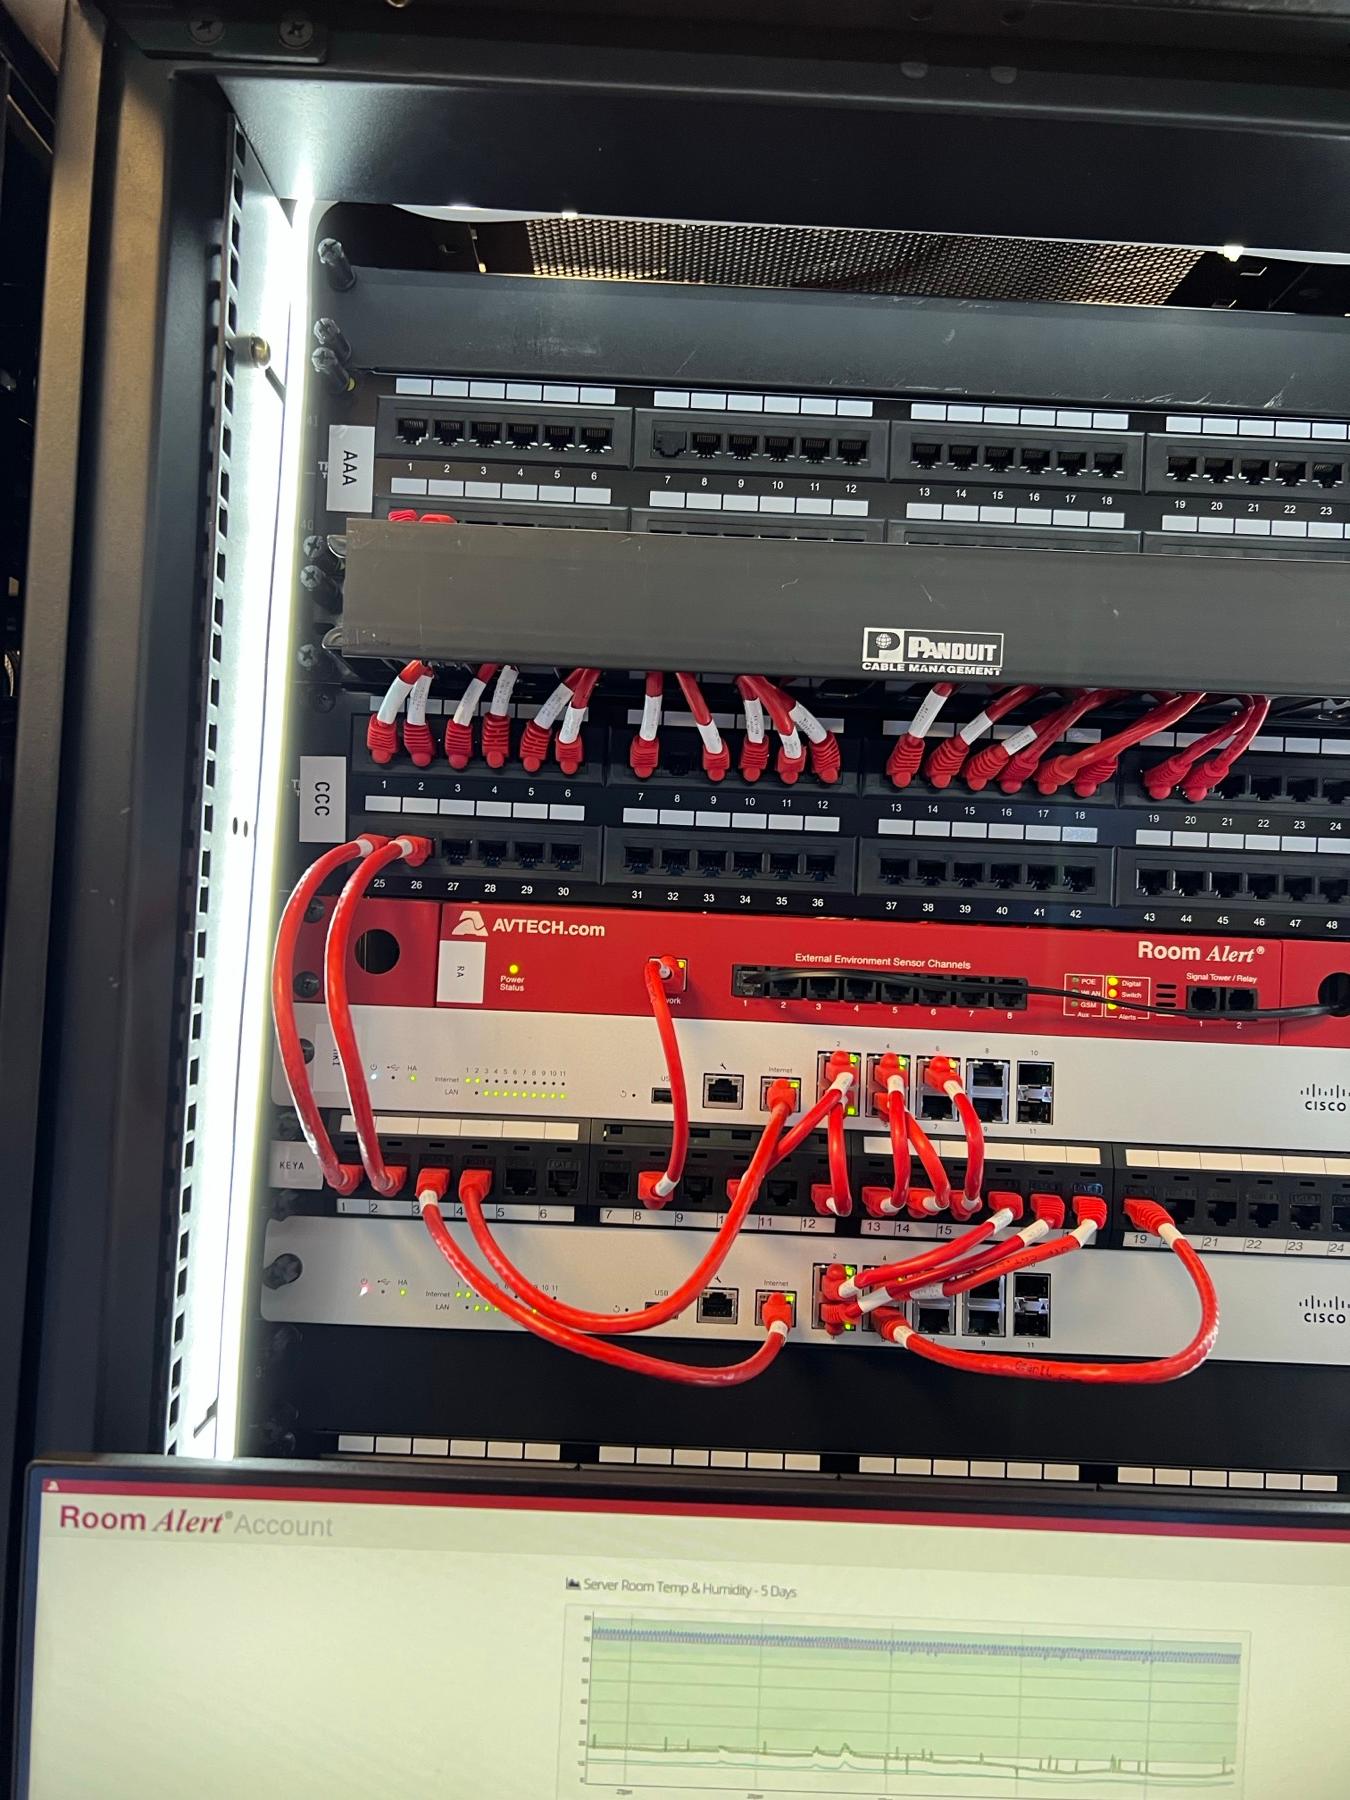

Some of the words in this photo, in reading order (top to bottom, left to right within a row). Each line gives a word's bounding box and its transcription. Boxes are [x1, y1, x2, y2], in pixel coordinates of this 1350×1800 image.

[343, 451, 357, 485] AAA
[444, 464, 449, 472] 2
[518, 468, 523, 476] 4
[555, 470, 560, 478] 5
[591, 472, 597, 480] 6
[665, 476, 670, 484] 7
[702, 478, 707, 486] 8
[738, 479, 744, 487] 9
[773, 481, 783, 489] 10
[811, 483, 819, 491] 11
[846, 484, 856, 493] 12
[920, 488, 929, 496] 13
[993, 491, 1003, 499] 15
[1029, 493, 1039, 501] 16
[1066, 495, 1076, 503] 17
[1211, 502, 1222, 510] 20
[1285, 505, 1295, 513] 22
[1320, 507, 1332, 515] 23
[907, 636, 998, 662] PANDUIT
[862, 662, 905, 672] CABLE
[908, 664, 1002, 676] MANAGEMENT
[315, 782, 330, 816] CCC
[418, 782, 424, 790] 2
[455, 784, 460, 792] 3
[529, 788, 534, 796] 5
[565, 789, 571, 797] 6
[675, 794, 680, 802] 8
[711, 796, 716, 804] 9
[818, 801, 828, 809] 12
[892, 804, 901, 812] 13
[928, 805, 937, 813] 14
[1002, 808, 1012, 816] 16
[1185, 816, 1196, 824] 20
[1294, 821, 1305, 829] 23
[1330, 822, 1341, 830] 24
[374, 879, 385, 888] 25
[411, 881, 422, 889] 26
[448, 882, 459, 890] 27
[485, 884, 496, 892] 28
[521, 886, 532, 894] 29
[558, 887, 569, 895] 30
[668, 892, 678, 900] 32
[704, 894, 714, 902] 33
[777, 897, 787, 905] 35
[886, 902, 897, 910] 37
[923, 903, 933, 911] 38
[960, 905, 971, 913] 39
[1070, 910, 1081, 918] 42
[1144, 913, 1155, 921] 43
[1218, 916, 1228, 924] 45
[1254, 918, 1265, 926] 46
[1326, 921, 1337, 929] 48
[492, 918, 605, 937] AVTECH.com
[1138, 941, 1201, 961] Room
[795, 953, 832, 963] External
[834, 955, 891, 966] Environment
[893, 957, 925, 967] Sensor
[928, 959, 971, 970] Channels
[499, 983, 525, 992] Status
[500, 975, 525, 984] Power
[1121, 980, 1141, 988] Digital
[1186, 973, 1208, 982] Signal
[1209, 973, 1232, 982] Tower
[1236, 975, 1258, 984] Relay
[930, 1008, 936, 1016] 6
[1304, 1100, 1346, 1112] CISCO
[280, 1161, 304, 1170] KEYA
[370, 1204, 378, 1213] 2
[412, 1204, 420, 1216] 3
[456, 1206, 464, 1217] 4
[496, 1206, 504, 1218] 5
[539, 1208, 547, 1219] 6
[606, 1209, 612, 1219] 7
[634, 1210, 642, 1221] 8
[676, 1212, 684, 1223] 9
[760, 1217, 772, 1227] 11
[802, 1218, 816, 1229] 12
[867, 1222, 881, 1232] 13
[896, 1223, 910, 1233] 14
[938, 1225, 952, 1235] 15
[1134, 1234, 1148, 1244] 19
[1204, 1237, 1218, 1247] 21
[1246, 1239, 1262, 1249] 22
[1288, 1241, 1304, 1251] 23
[1328, 1243, 1344, 1253] 24
[1304, 1313, 1346, 1324] CISCO
[60, 1505, 146, 1531] Room
[233, 1514, 333, 1537] Account
[584, 1578, 619, 1592] Server
[621, 1580, 654, 1592] Room
[657, 1582, 689, 1596] Temp
[692, 1582, 701, 1594] &
[702, 1582, 752, 1598] Humidity
[761, 1585, 768, 1596] 5
[770, 1585, 798, 1599] Days
